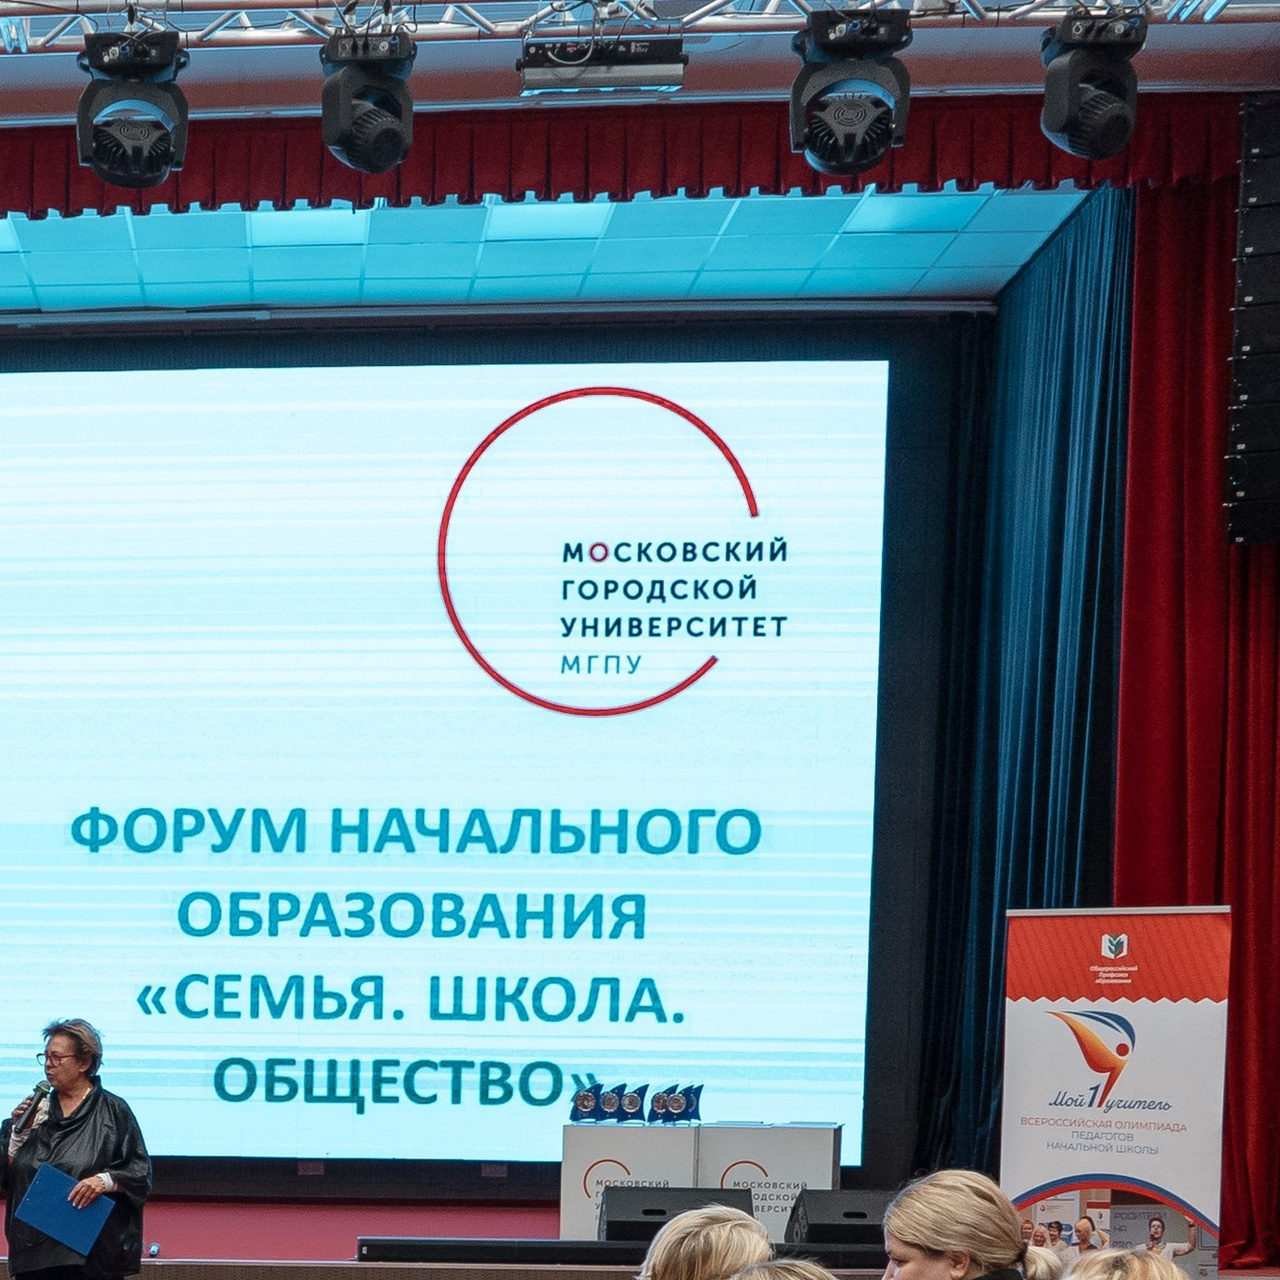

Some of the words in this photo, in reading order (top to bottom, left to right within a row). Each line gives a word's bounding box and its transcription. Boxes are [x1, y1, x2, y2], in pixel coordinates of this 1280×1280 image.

[563, 537, 788, 562] МОСКОВСКИЙ
[563, 574, 757, 603] ГОРОДСКОЙ
[561, 616, 788, 637] УНИВЕРСИТЕТ
[561, 655, 642, 675] МГПУ
[70, 806, 307, 854] ФОРУМ
[330, 807, 762, 856] НАЧАЛЬНОГО
[177, 891, 646, 940] ОБРАЗОВАНИЯ
[136, 973, 405, 1021] «СЕМЬЯ.
[429, 975, 685, 1024] ШКОЛА.
[1049, 1091, 1085, 1107] Мой
[1103, 1099, 1172, 1114] учитель
[1020, 1117, 1112, 1129] ВСЕРОССИЙСКАЯ
[1114, 1121, 1188, 1133] ОЛИМПИАДА
[1071, 1130, 1134, 1142] ПЕДАГОГОВ
[1046, 1142, 1113, 1153] НАЧАЛЬНОЙ
[1116, 1145, 1159, 1155] ШКОЛЫ
[596, 1180, 669, 1188] МОСКОВСКИЙ
[733, 1181, 807, 1189] МОСКОВСКИЙ
[753, 1193, 798, 1202] ОДСКОЙ
